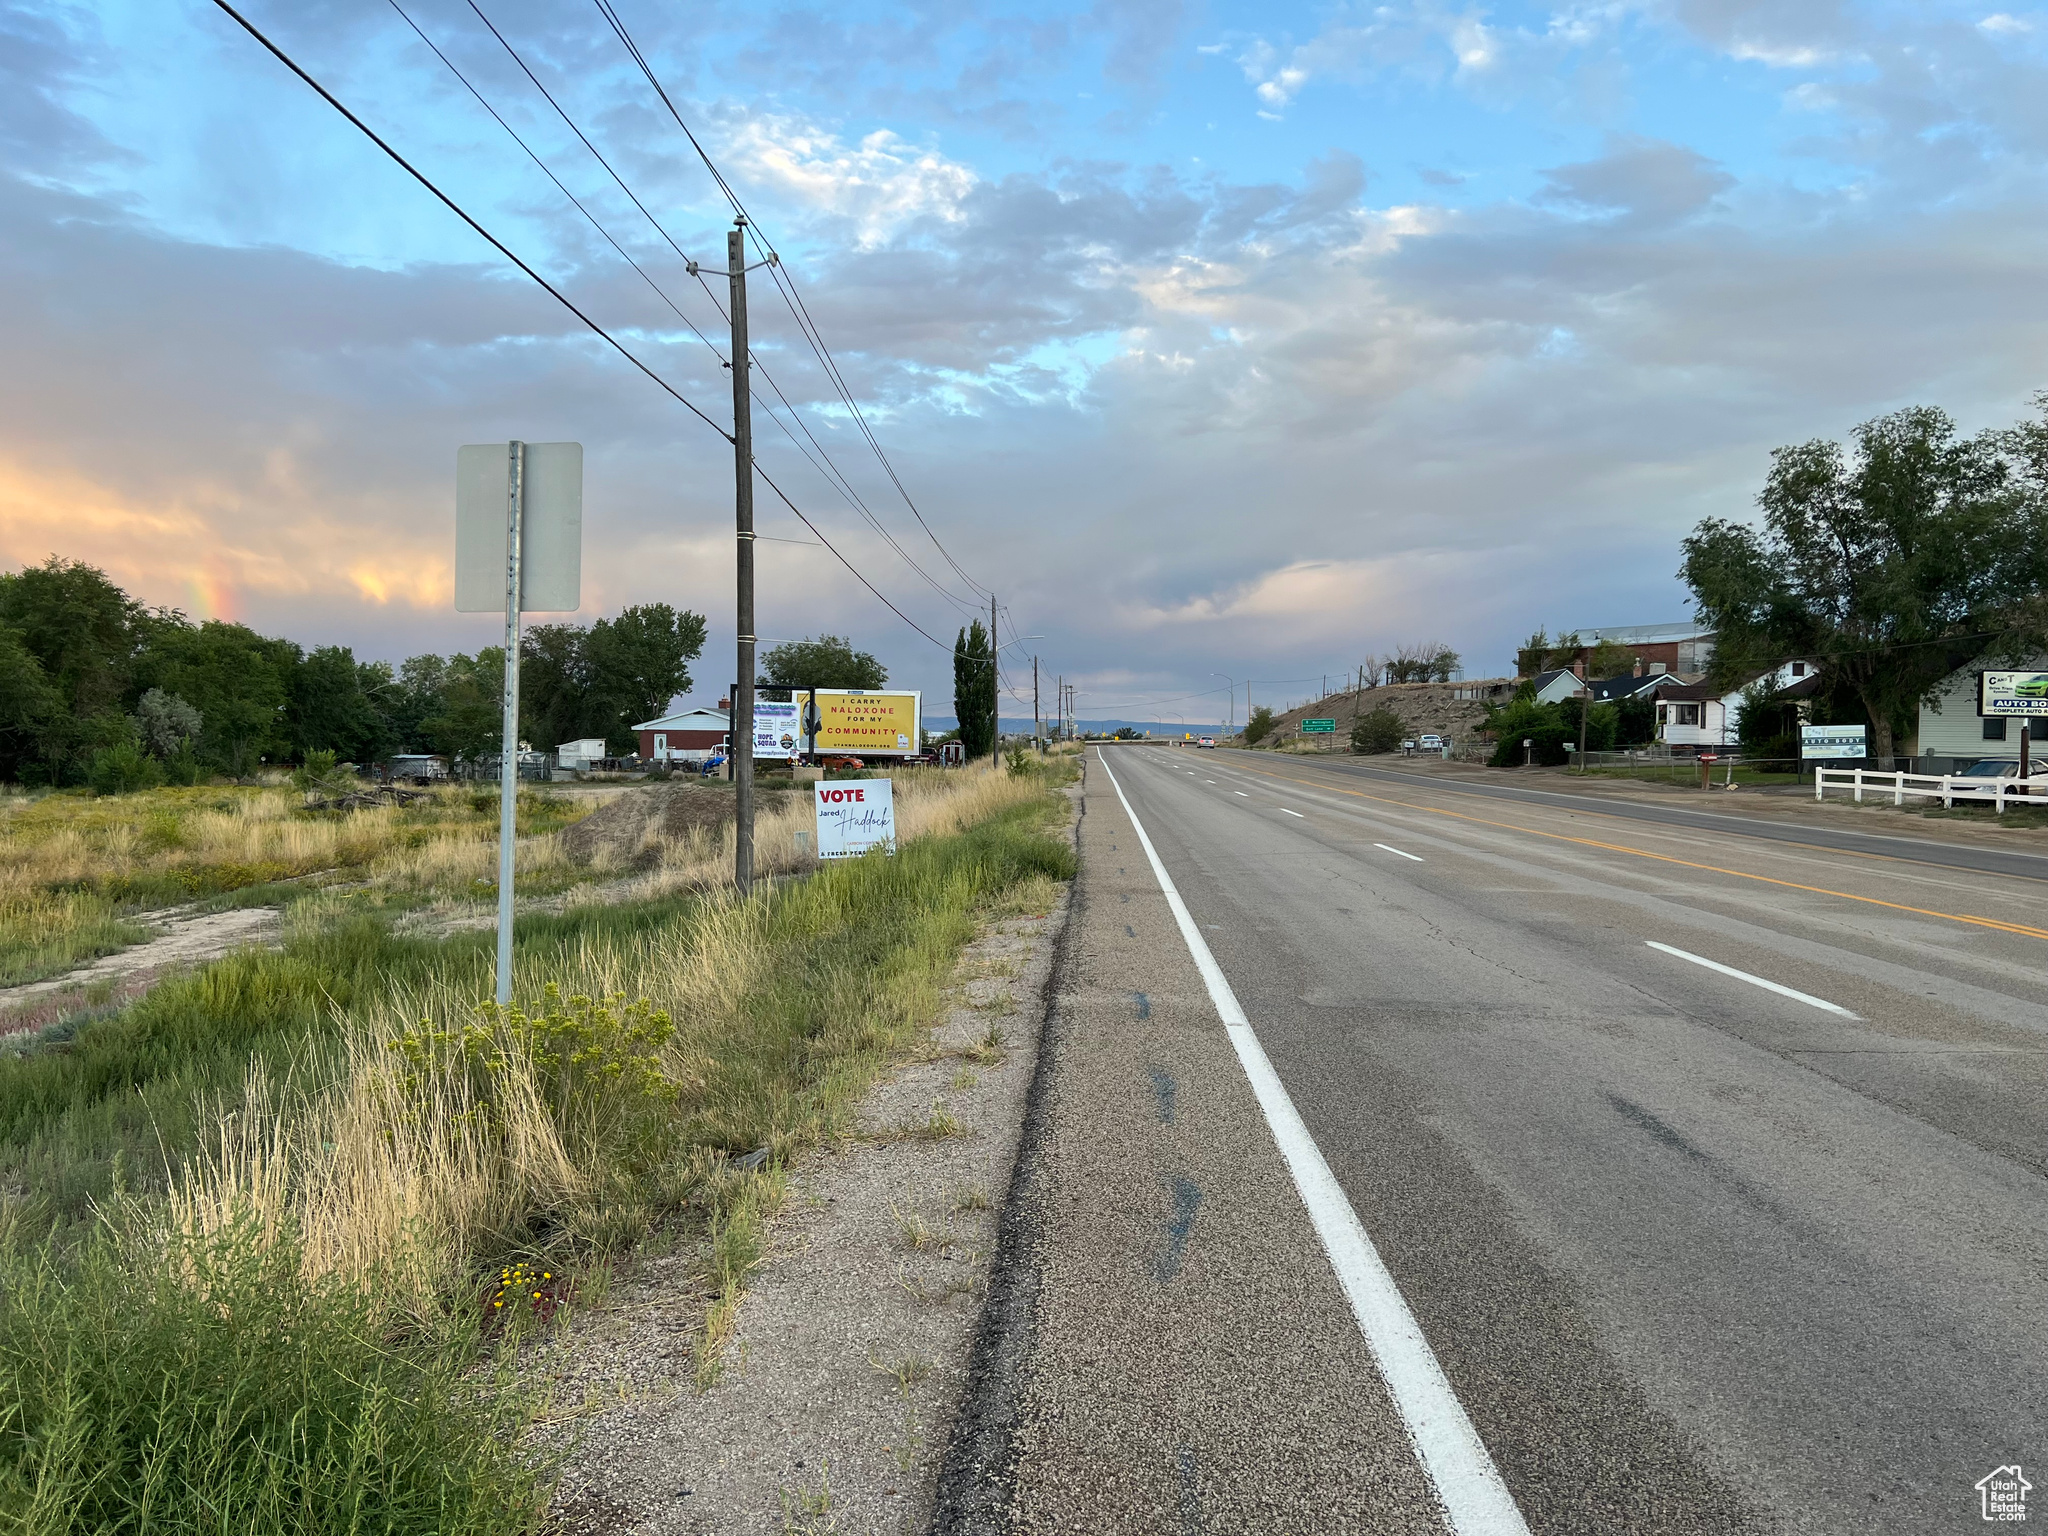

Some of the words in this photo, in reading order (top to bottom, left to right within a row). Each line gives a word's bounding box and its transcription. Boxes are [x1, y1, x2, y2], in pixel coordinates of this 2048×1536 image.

[1989, 676, 1996, 685] C
[830, 706, 895, 714] NALOXONE
[827, 727, 897, 735] COMMUNITY
[819, 789, 865, 803] VOTE
[819, 809, 840, 817] Jared
[834, 807, 890, 836] Haddock
